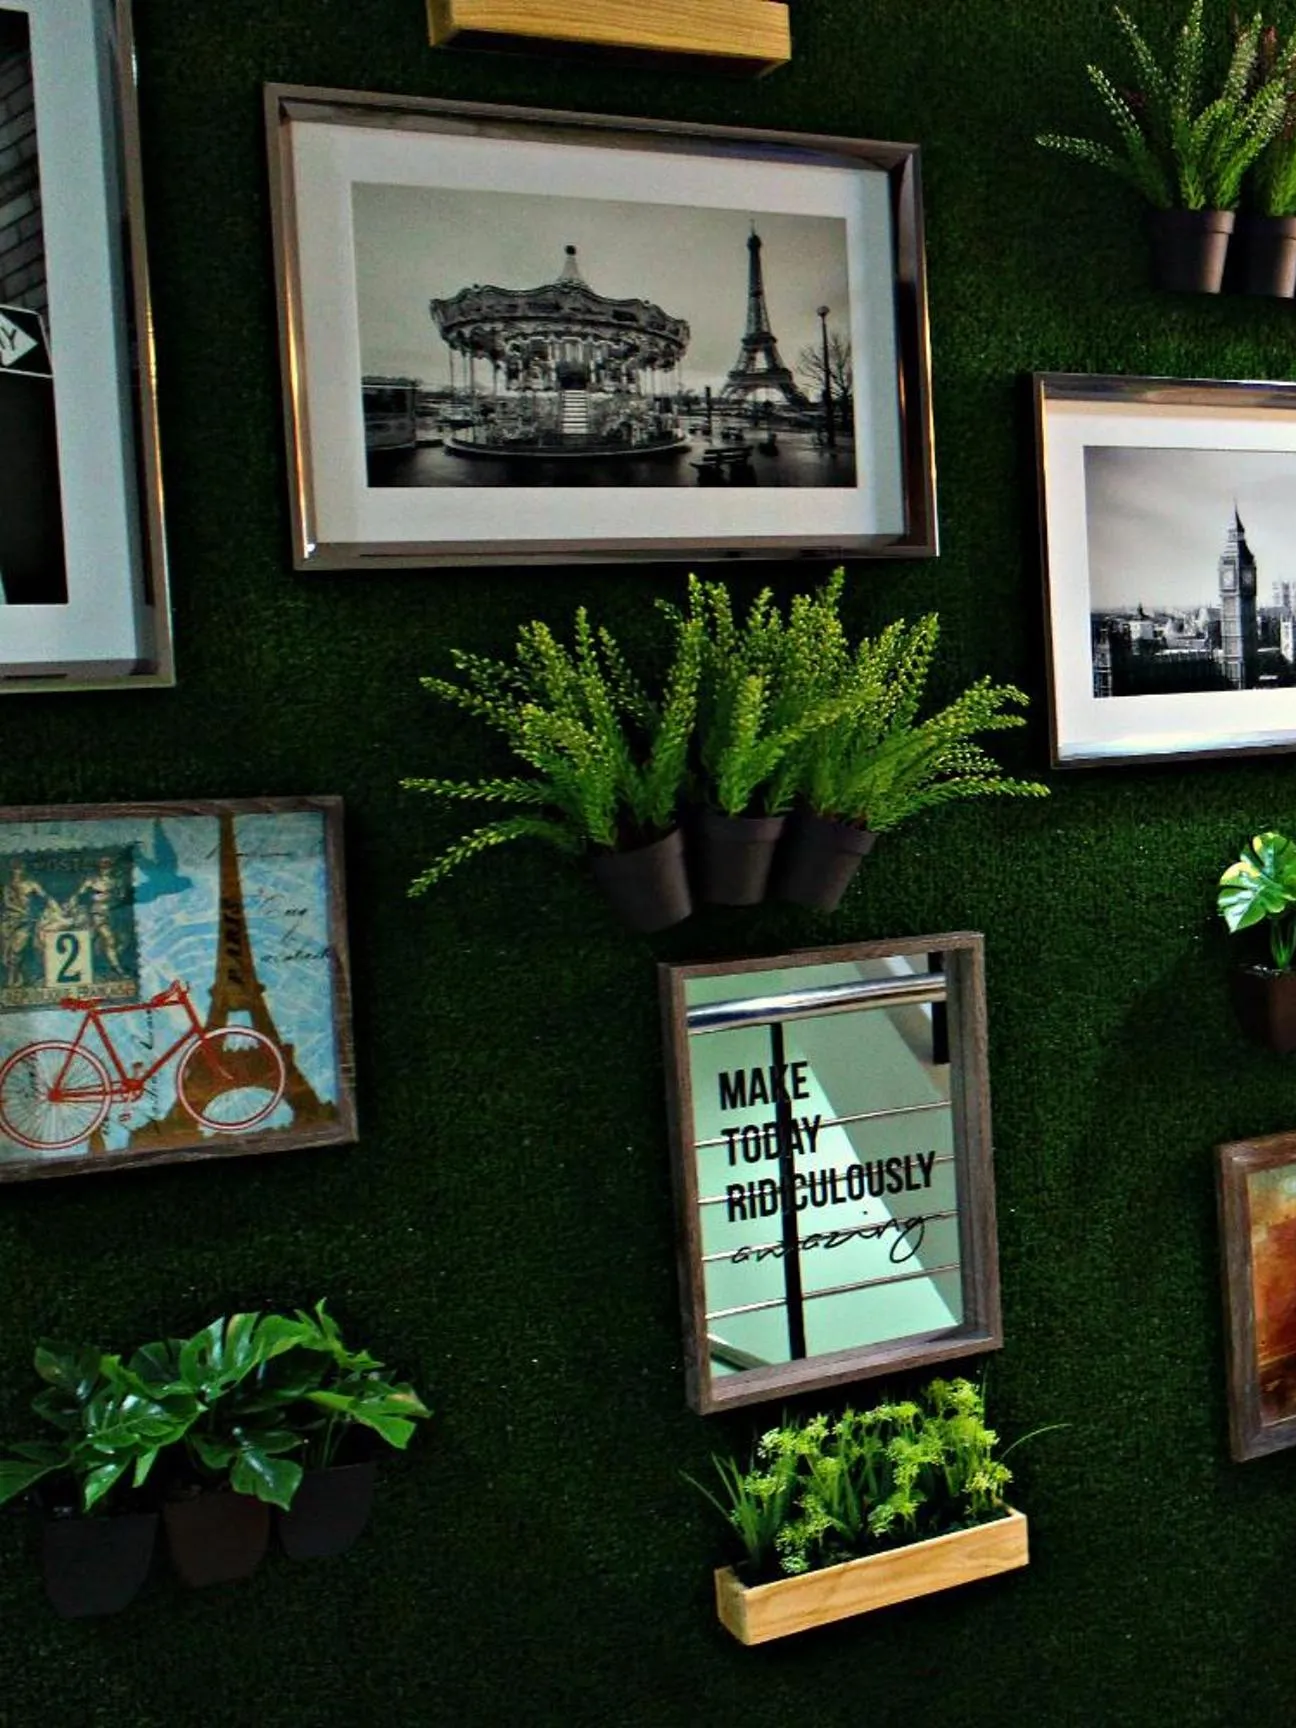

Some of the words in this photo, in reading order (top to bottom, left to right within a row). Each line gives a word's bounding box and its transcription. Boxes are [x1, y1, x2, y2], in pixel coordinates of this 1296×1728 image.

[56, 932, 81, 983] 2
[718, 1061, 809, 1111] MAKE
[721, 1114, 821, 1166] TODAY
[726, 1151, 936, 1222] RIDICULOUSLY
